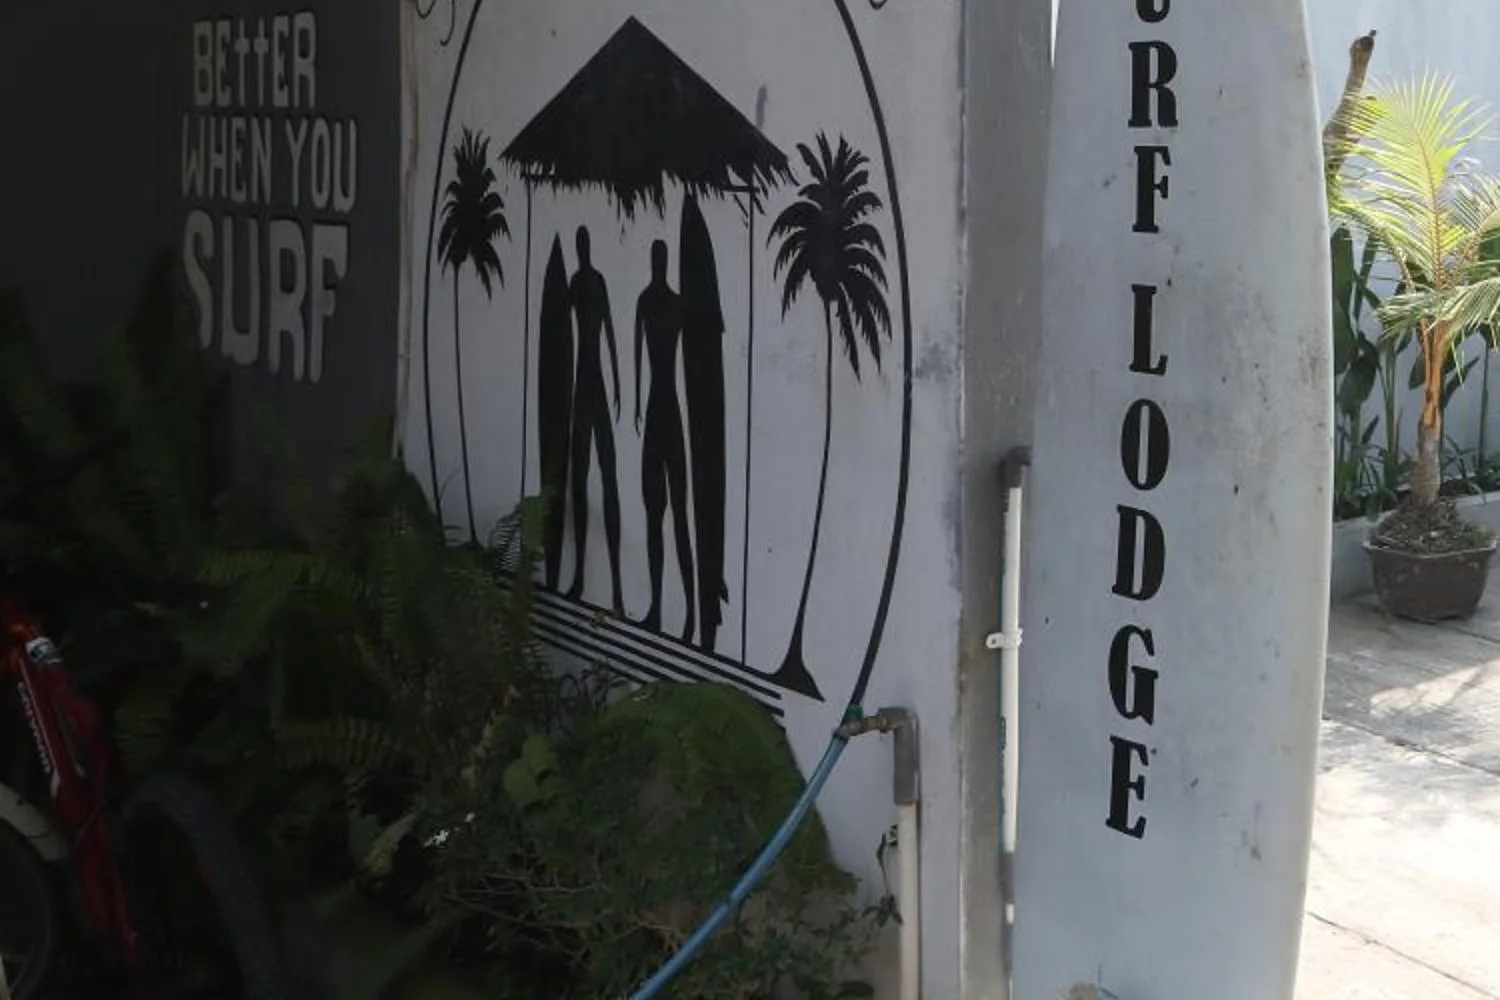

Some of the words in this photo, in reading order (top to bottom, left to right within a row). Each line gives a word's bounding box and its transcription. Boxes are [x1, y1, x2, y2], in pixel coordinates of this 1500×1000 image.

[182, 112, 272, 205] WHEN
[285, 117, 357, 213] YOU
[183, 209, 348, 384] SURF
[1105, 283, 1171, 840] LODGE
